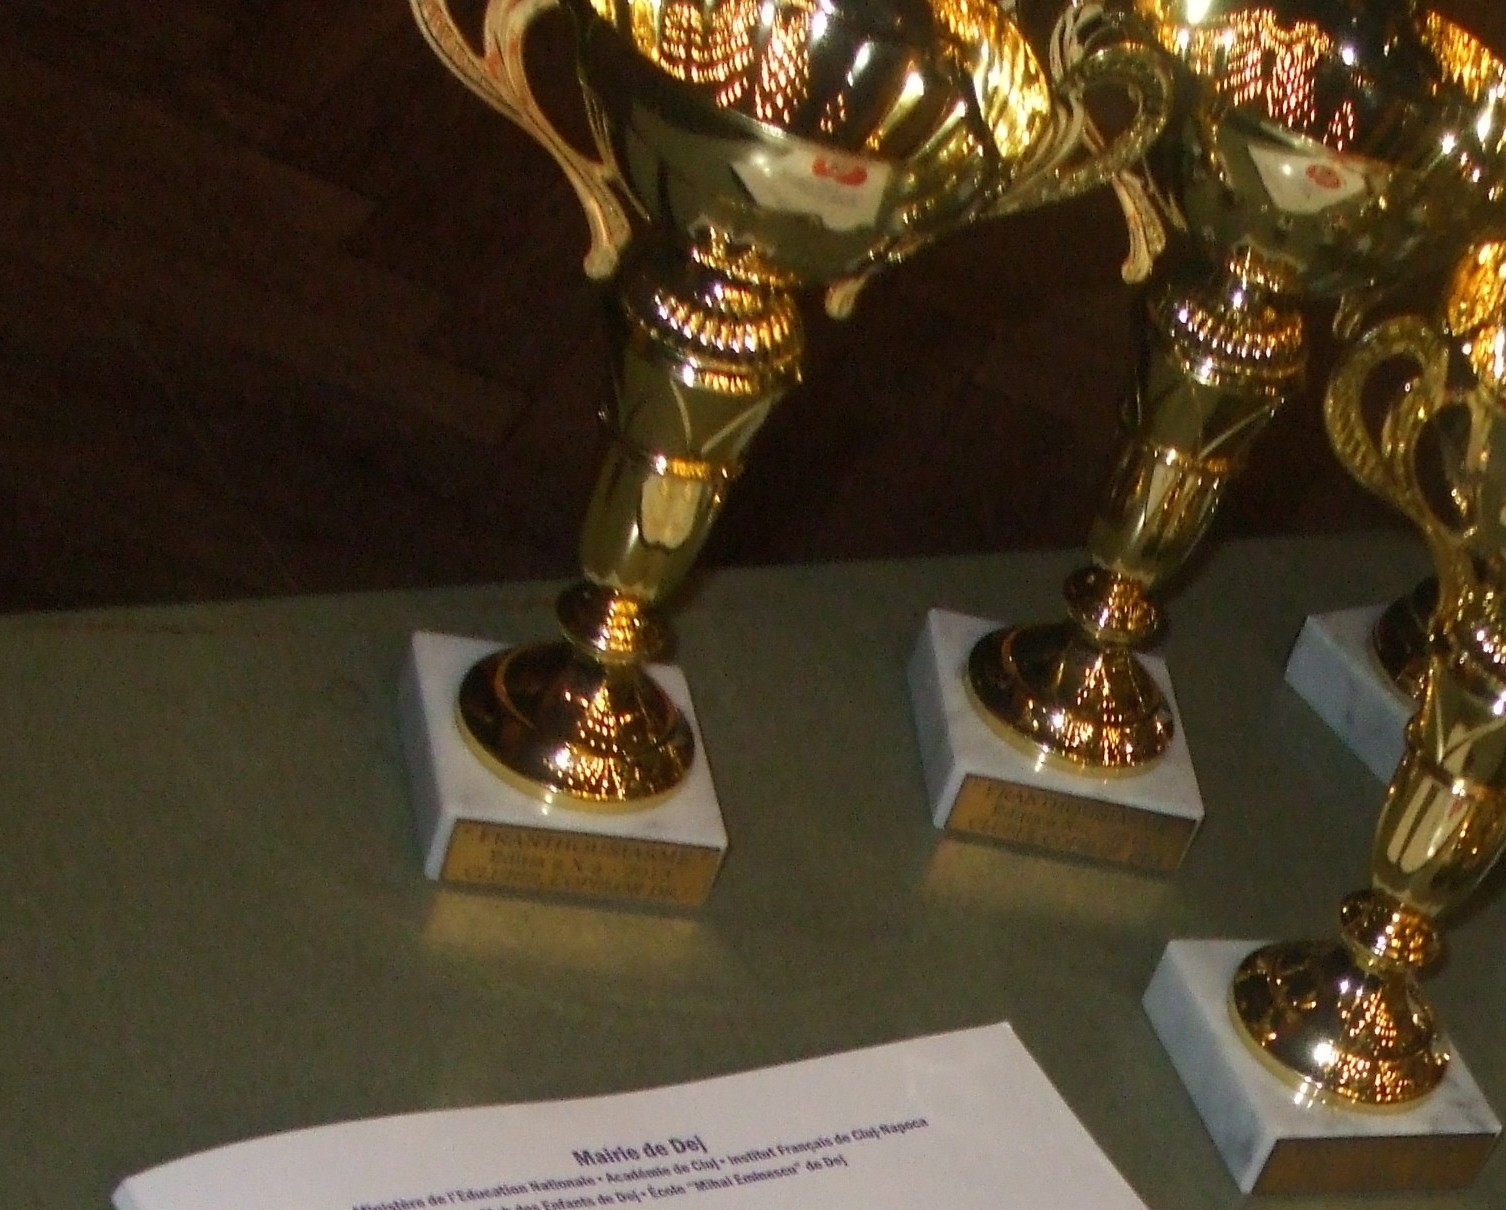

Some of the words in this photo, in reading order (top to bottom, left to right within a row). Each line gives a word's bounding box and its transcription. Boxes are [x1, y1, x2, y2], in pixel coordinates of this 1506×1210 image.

[428, 1193, 446, 1206] de
[528, 1176, 596, 1193] Nationale
[605, 1167, 672, 1183] Académie
[673, 1163, 690, 1175] de
[691, 1158, 720, 1171] Cluj
[728, 1148, 776, 1166] Institut
[777, 1137, 833, 1156] Français
[834, 1133, 850, 1146] de
[572, 1145, 640, 1166] Mairie
[642, 1141, 669, 1159] de
[668, 1135, 708, 1153] Dej
[597, 1194, 614, 1205] de
[615, 1190, 642, 1204] Dej
[805, 1159, 822, 1172] de
[822, 1154, 849, 1167] Dej
